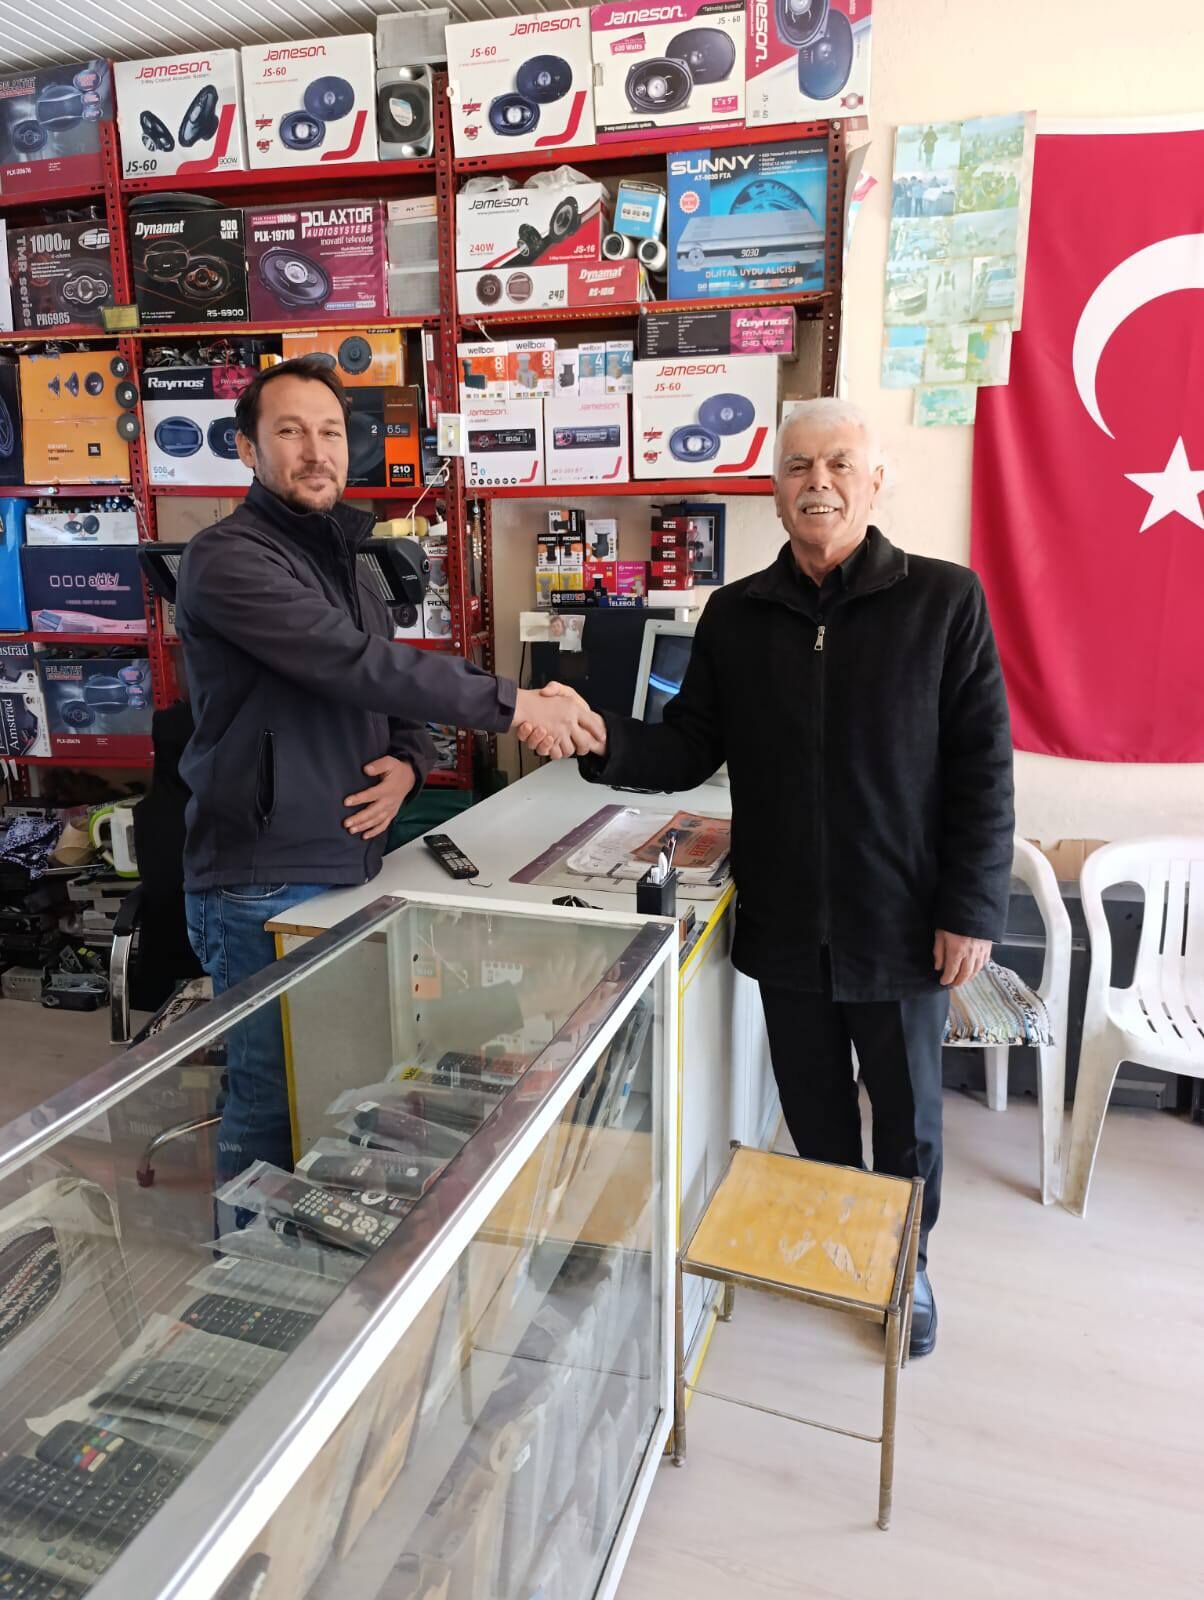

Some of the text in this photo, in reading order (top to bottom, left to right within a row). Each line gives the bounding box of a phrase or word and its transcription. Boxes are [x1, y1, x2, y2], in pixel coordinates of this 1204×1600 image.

[604, 6, 683, 26] Jameson
[510, 16, 583, 36] Jameson
[263, 46, 326, 62] Jameson
[470, 47, 497, 58] JS-60
[135, 61, 211, 79] Jameson
[263, 67, 287, 77] JS-60
[126, 159, 158, 173] JS-60
[671, 155, 755, 175] SUNNY
[469, 197, 529, 210] Jameson
[220, 220, 238, 231] 900
[301, 207, 373, 239] POLAXTOR
[135, 221, 185, 238] Dynamat
[220, 230, 239, 240] WATT
[254, 229, 296, 242] PLX-19710
[17, 235, 27, 272] TMR
[469, 243, 495, 253] 240W
[573, 244, 596, 254] JS-16
[741, 249, 760, 257] 9030
[579, 267, 624, 283] Dynamat
[740, 268, 763, 277] UYDU
[549, 290, 565, 300] 240
[36, 311, 71, 326] PR6985
[736, 317, 789, 329] Raymos
[467, 346, 495, 354] wellbox
[515, 341, 546, 350] wellbox
[543, 351, 551, 367] 8
[595, 353, 603, 365] 4
[622, 351, 630, 362] 4
[495, 356, 503, 370] 8
[656, 363, 727, 377] Jameson
[148, 377, 204, 391] Raymos
[654, 382, 682, 392] JS-60
[468, 408, 507, 416] Jameson
[579, 402, 620, 412] Jameson
[371, 425, 378, 434] 2
[392, 464, 411, 473] 210
[5, 698, 20, 750] Amstrad
